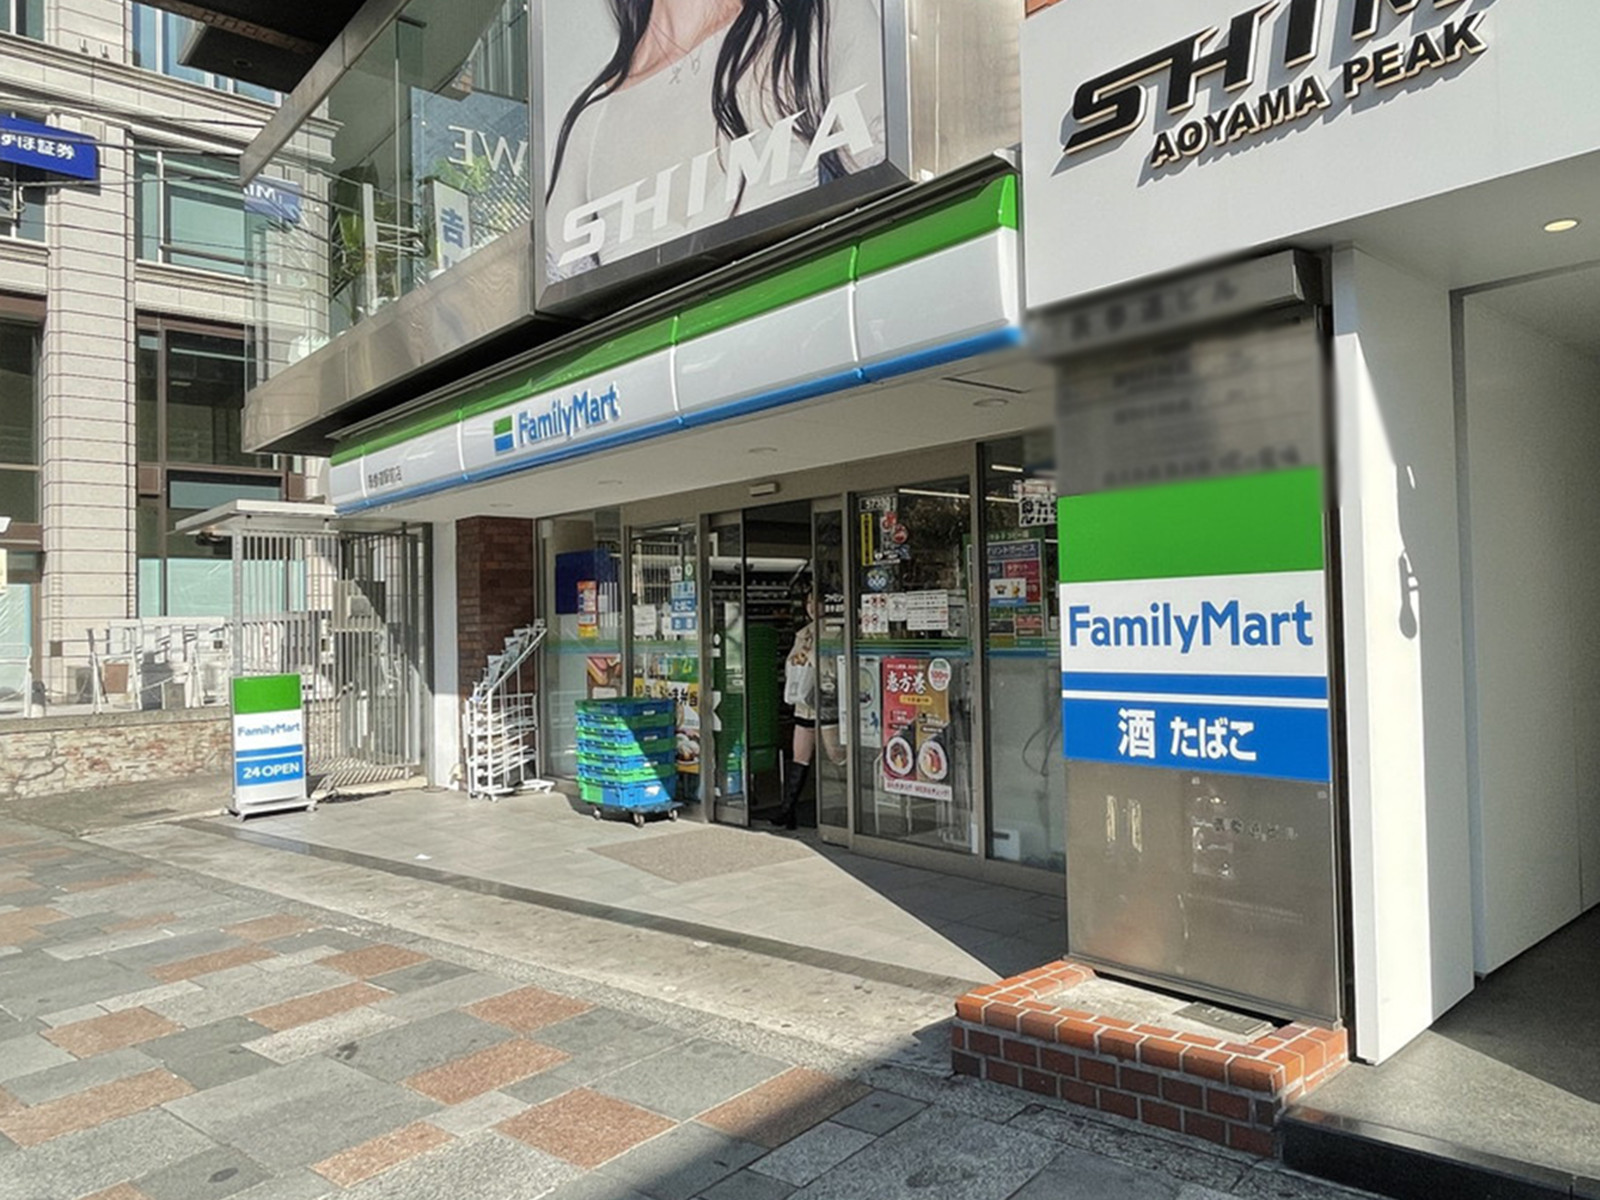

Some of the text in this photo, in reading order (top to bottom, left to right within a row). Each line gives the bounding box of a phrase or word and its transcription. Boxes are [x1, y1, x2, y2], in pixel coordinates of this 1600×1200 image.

[1149, 11, 1490, 168] AOYAMA PEAK
[558, 83, 873, 267] SHIMA
[518, 384, 620, 447] FamilyMart
[1068, 599, 1314, 654] FamilyMart
[237, 723, 300, 737] FamilyMart
[1117, 707, 1258, 762] 酒 たばこ
[261, 762, 300, 777] OPEN
